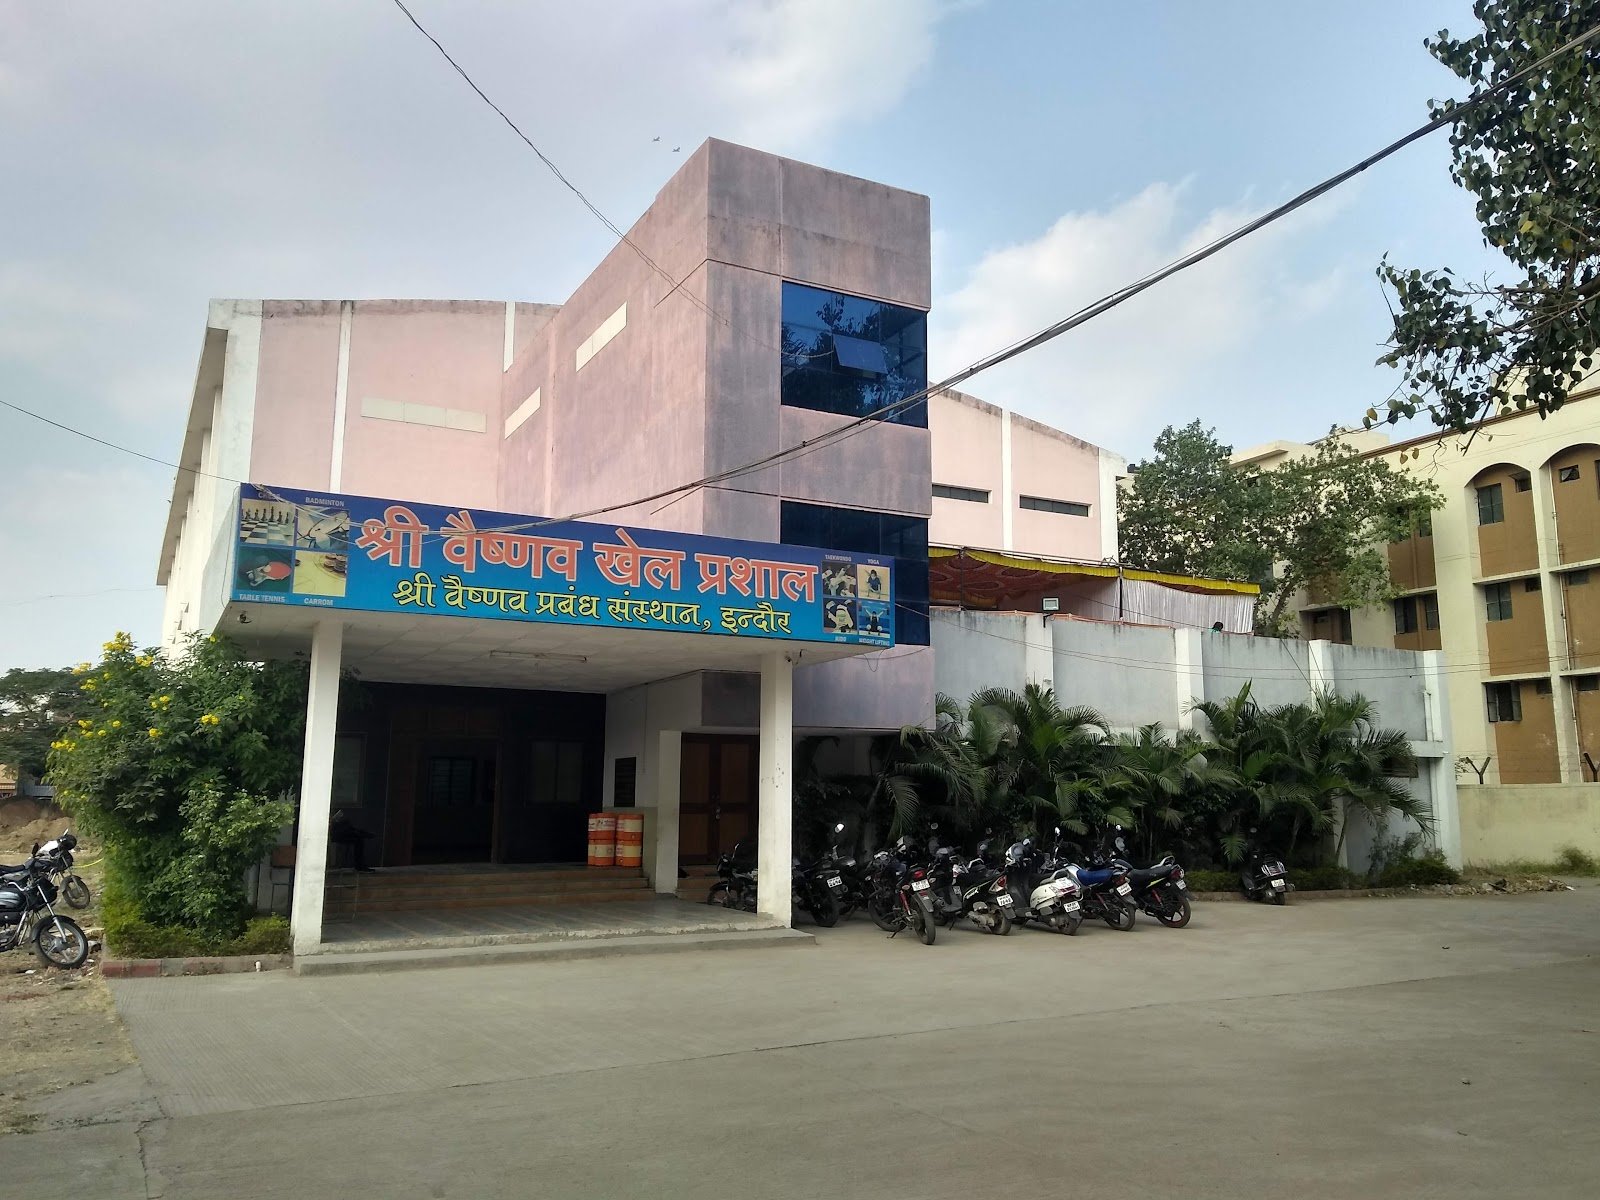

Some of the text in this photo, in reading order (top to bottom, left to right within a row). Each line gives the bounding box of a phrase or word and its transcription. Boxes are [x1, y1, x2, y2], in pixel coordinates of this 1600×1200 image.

[305, 497, 345, 507] BADMINTON
[355, 505, 819, 603] श्री वैष्णव खेल प्रशाल
[239, 593, 285, 603] TABLE TENNIS
[303, 597, 334, 606] CARROM
[393, 572, 792, 634] श्री वैष्णव प्रबंध संस्थान, इन्दौर
